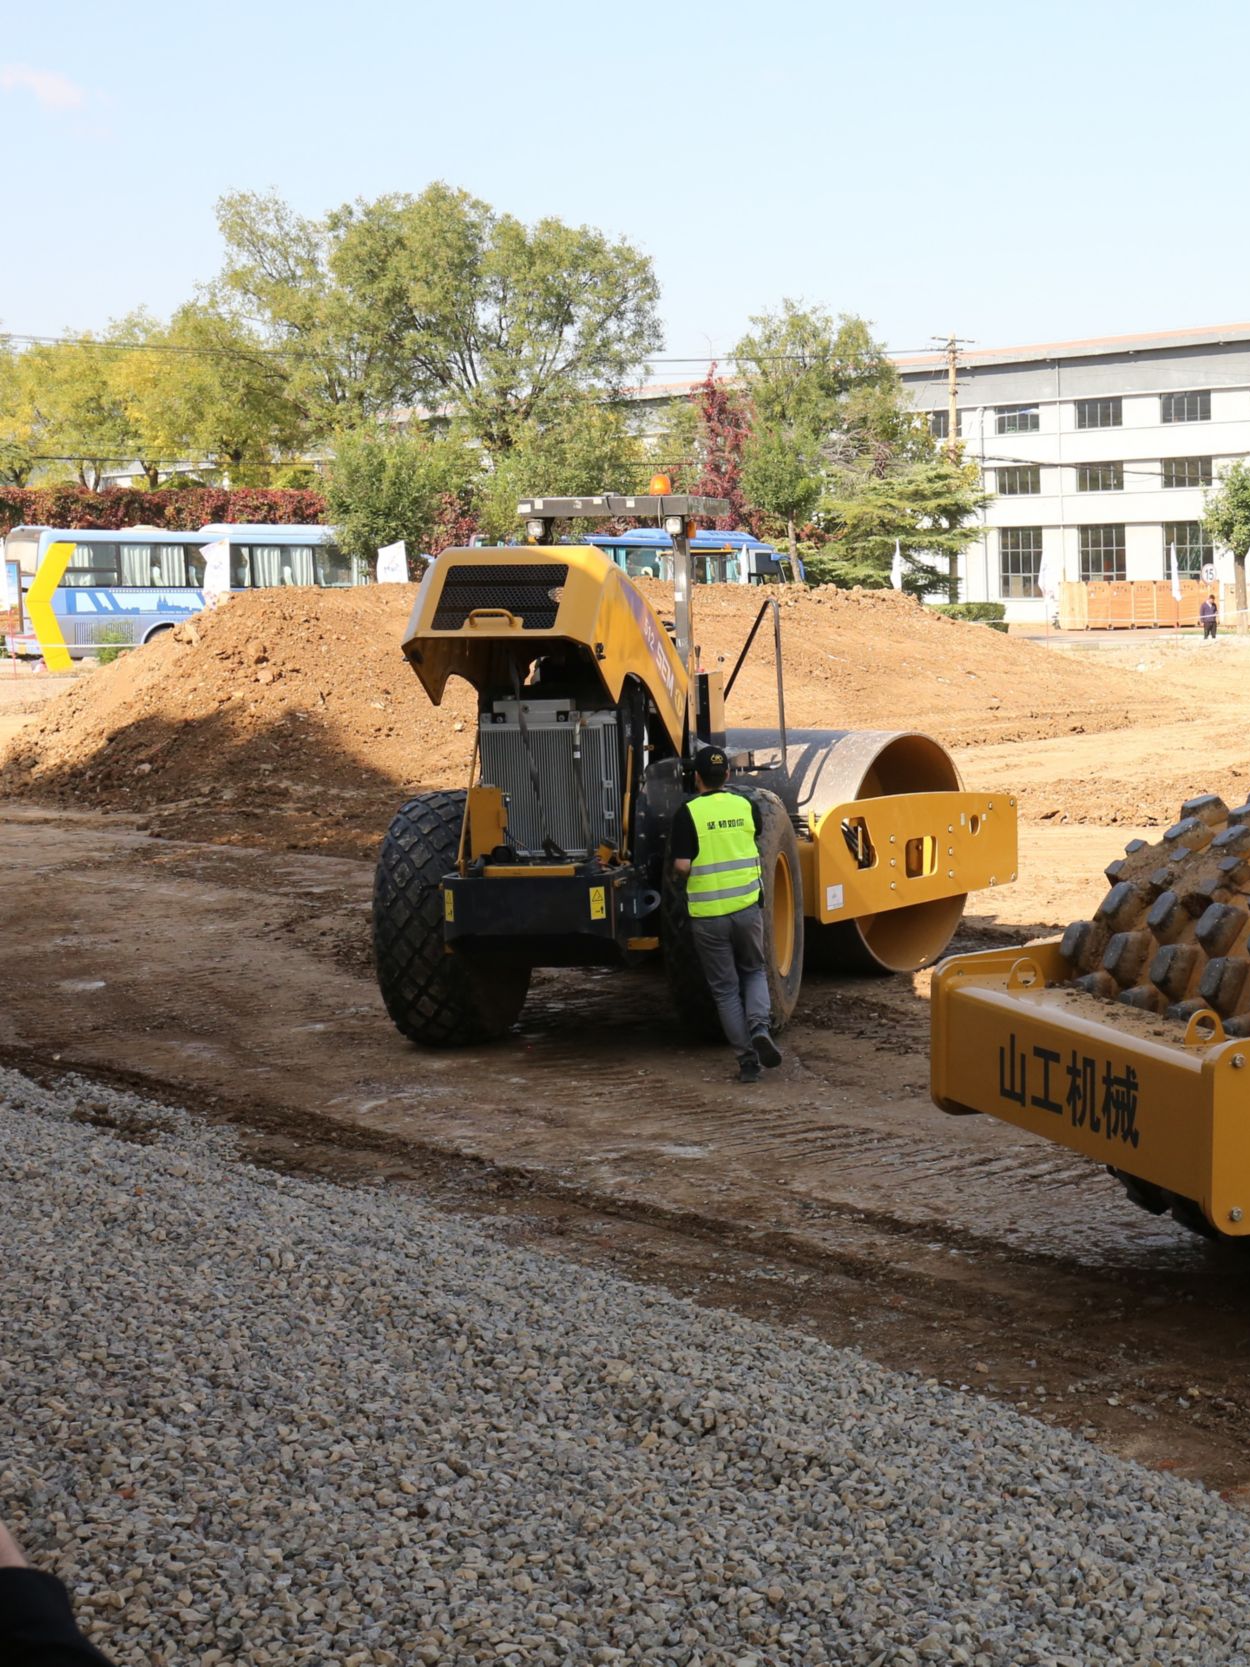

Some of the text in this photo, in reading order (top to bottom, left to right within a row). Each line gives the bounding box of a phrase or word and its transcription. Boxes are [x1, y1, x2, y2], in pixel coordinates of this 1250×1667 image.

[1205, 569, 1214, 580] 15
[656, 640, 675, 697] SEM
[999, 1033, 1140, 1149] 山工机械
